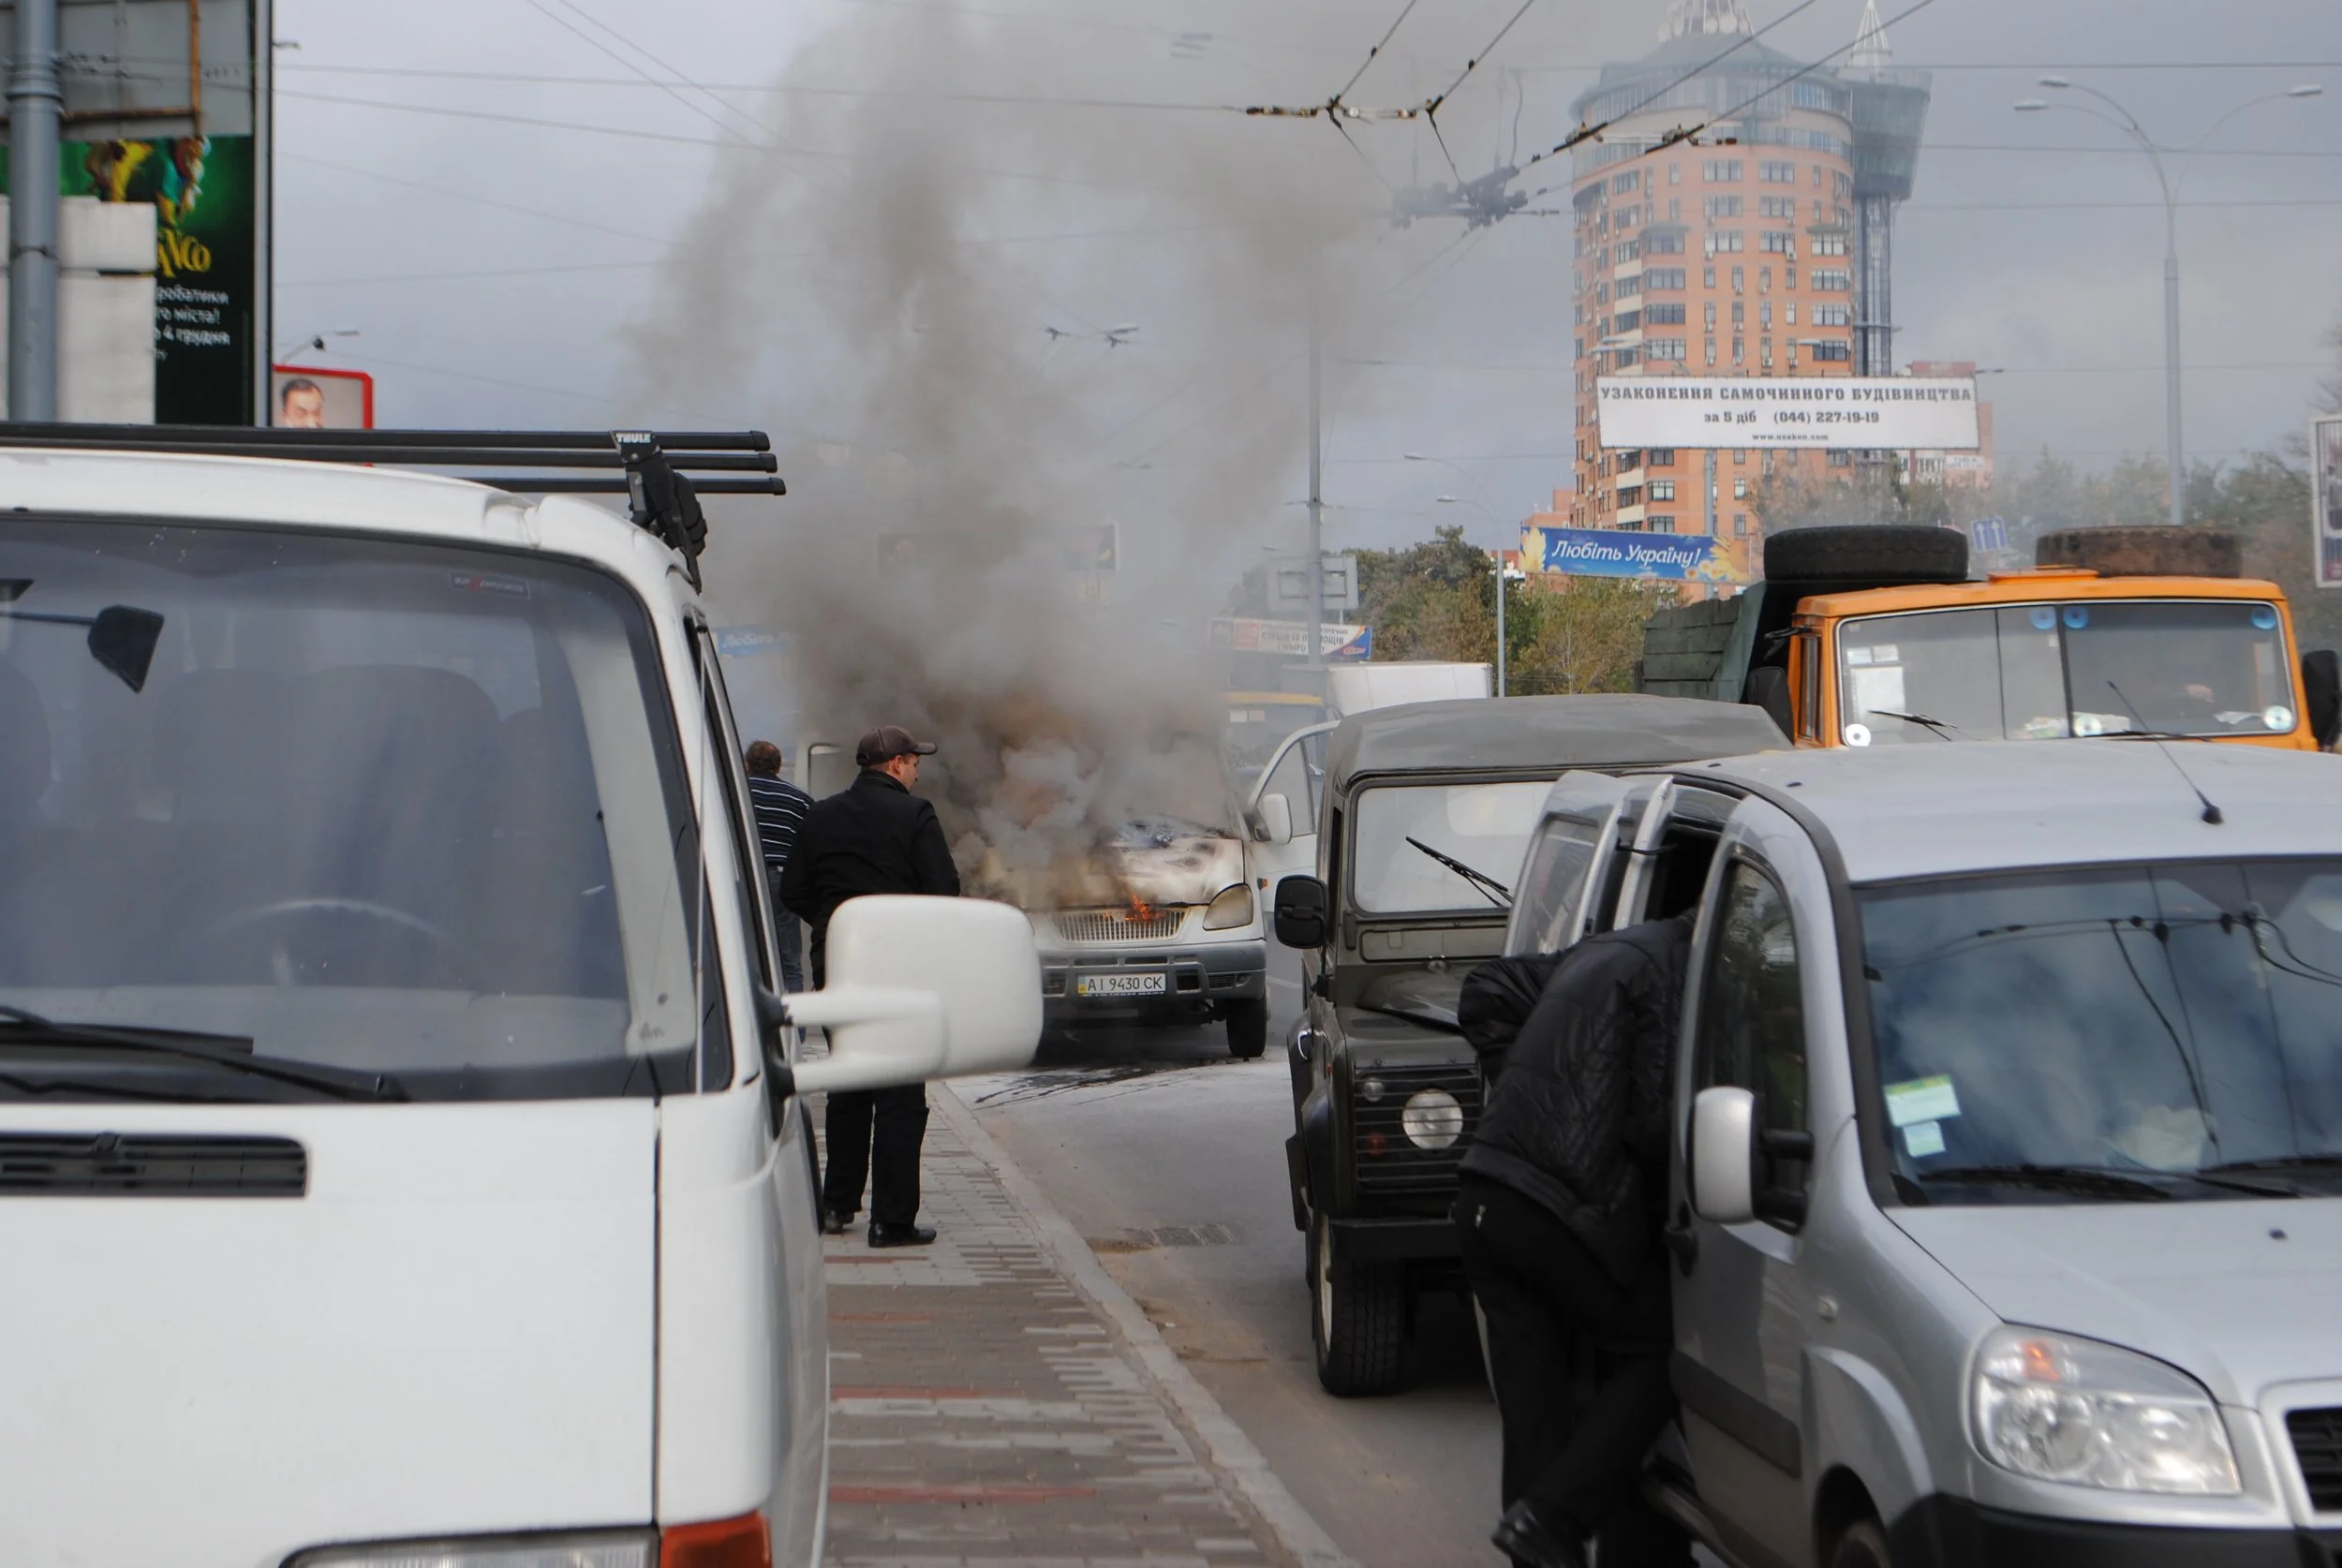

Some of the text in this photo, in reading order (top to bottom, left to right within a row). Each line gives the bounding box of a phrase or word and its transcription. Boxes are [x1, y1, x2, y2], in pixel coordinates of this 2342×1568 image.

[156, 285, 229, 305] робатики
[173, 305, 220, 324] міста!
[175, 328, 230, 347] грудня
[1600, 386, 1971, 403] УЗАКОНЕННЯ САМОЧИННОГО БУДІВНИЦТВА
[1704, 410, 1879, 425] за 5 діб (044) 227-19-19
[1551, 540, 1701, 568] Любіть Україну!
[1088, 976, 1162, 991] AI 9430 CK
